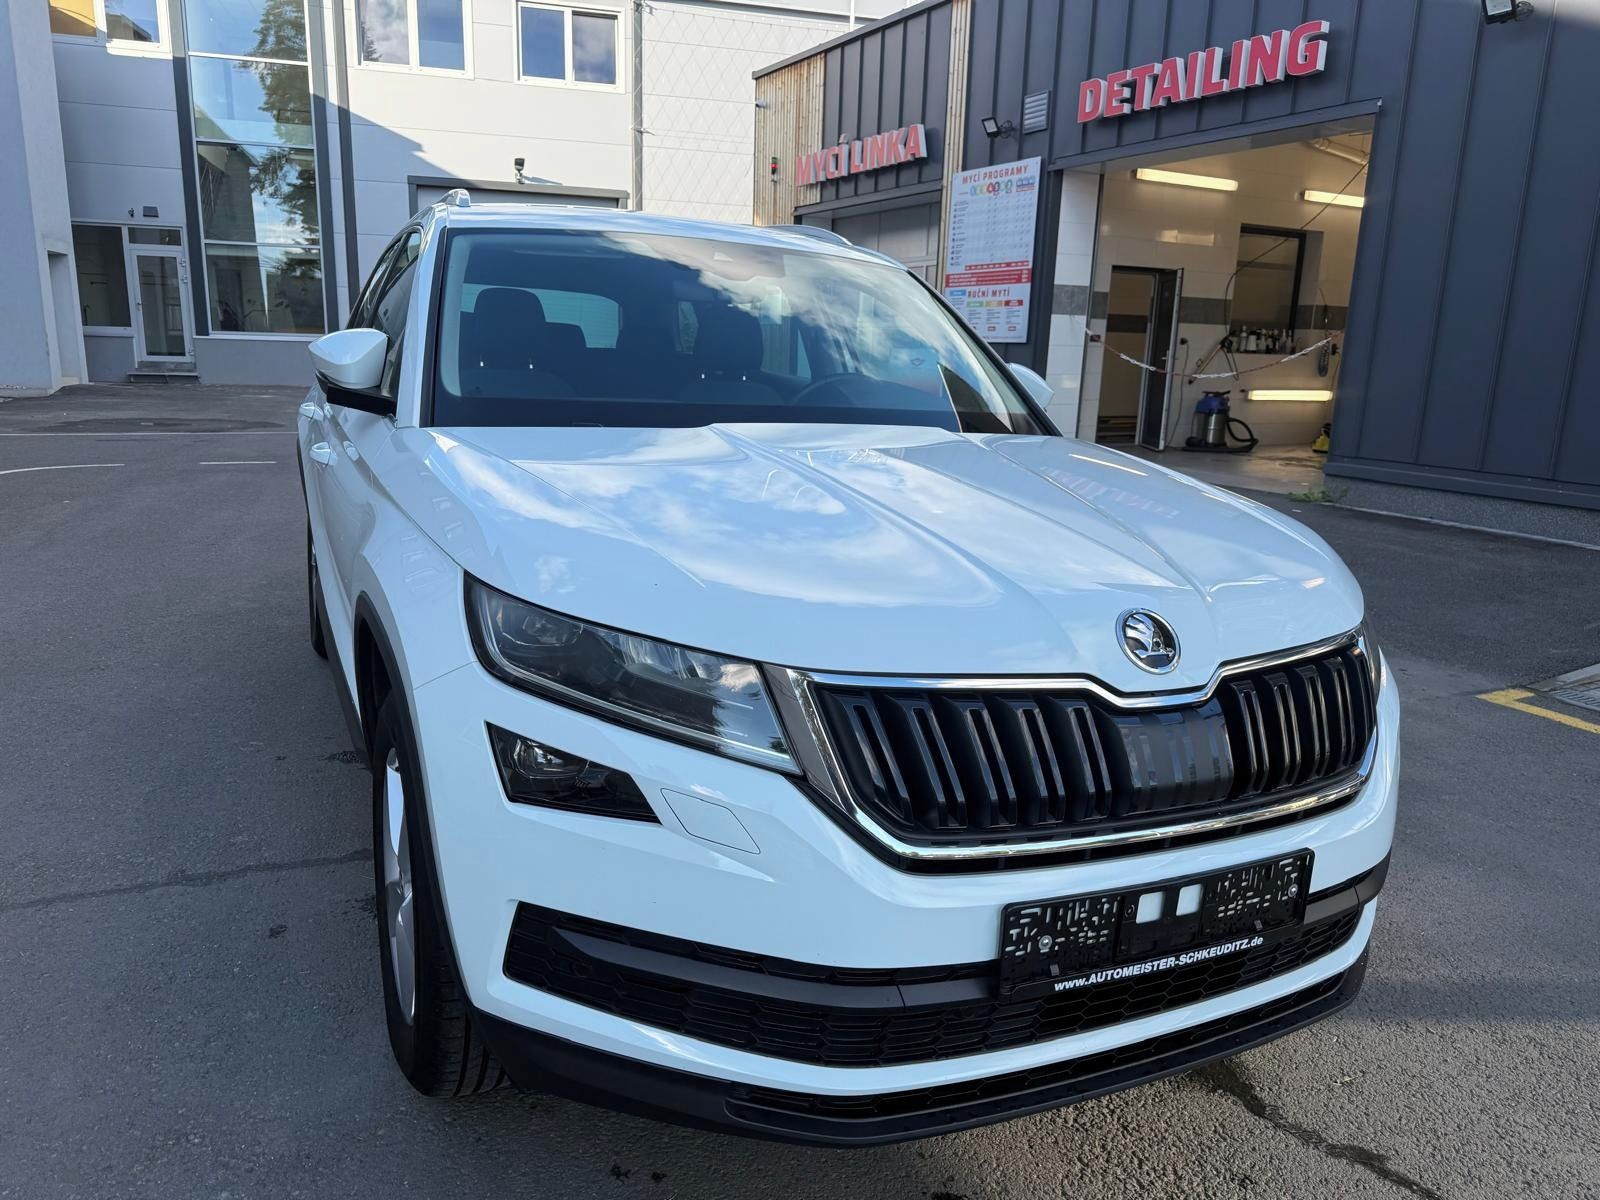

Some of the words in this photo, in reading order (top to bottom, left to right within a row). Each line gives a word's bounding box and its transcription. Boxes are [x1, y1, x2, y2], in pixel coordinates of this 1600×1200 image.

[1077, 20, 1330, 123] DETAILING
[796, 133, 849, 188] MYCÍ
[850, 124, 928, 174] LINKA
[962, 171, 981, 184] MYCÍ
[982, 164, 1028, 181] PROGRAMY
[991, 286, 1010, 297] MYTÍ
[1054, 936, 1264, 992] www.AUTOMEISTER-SCHKEUDITZ.de
